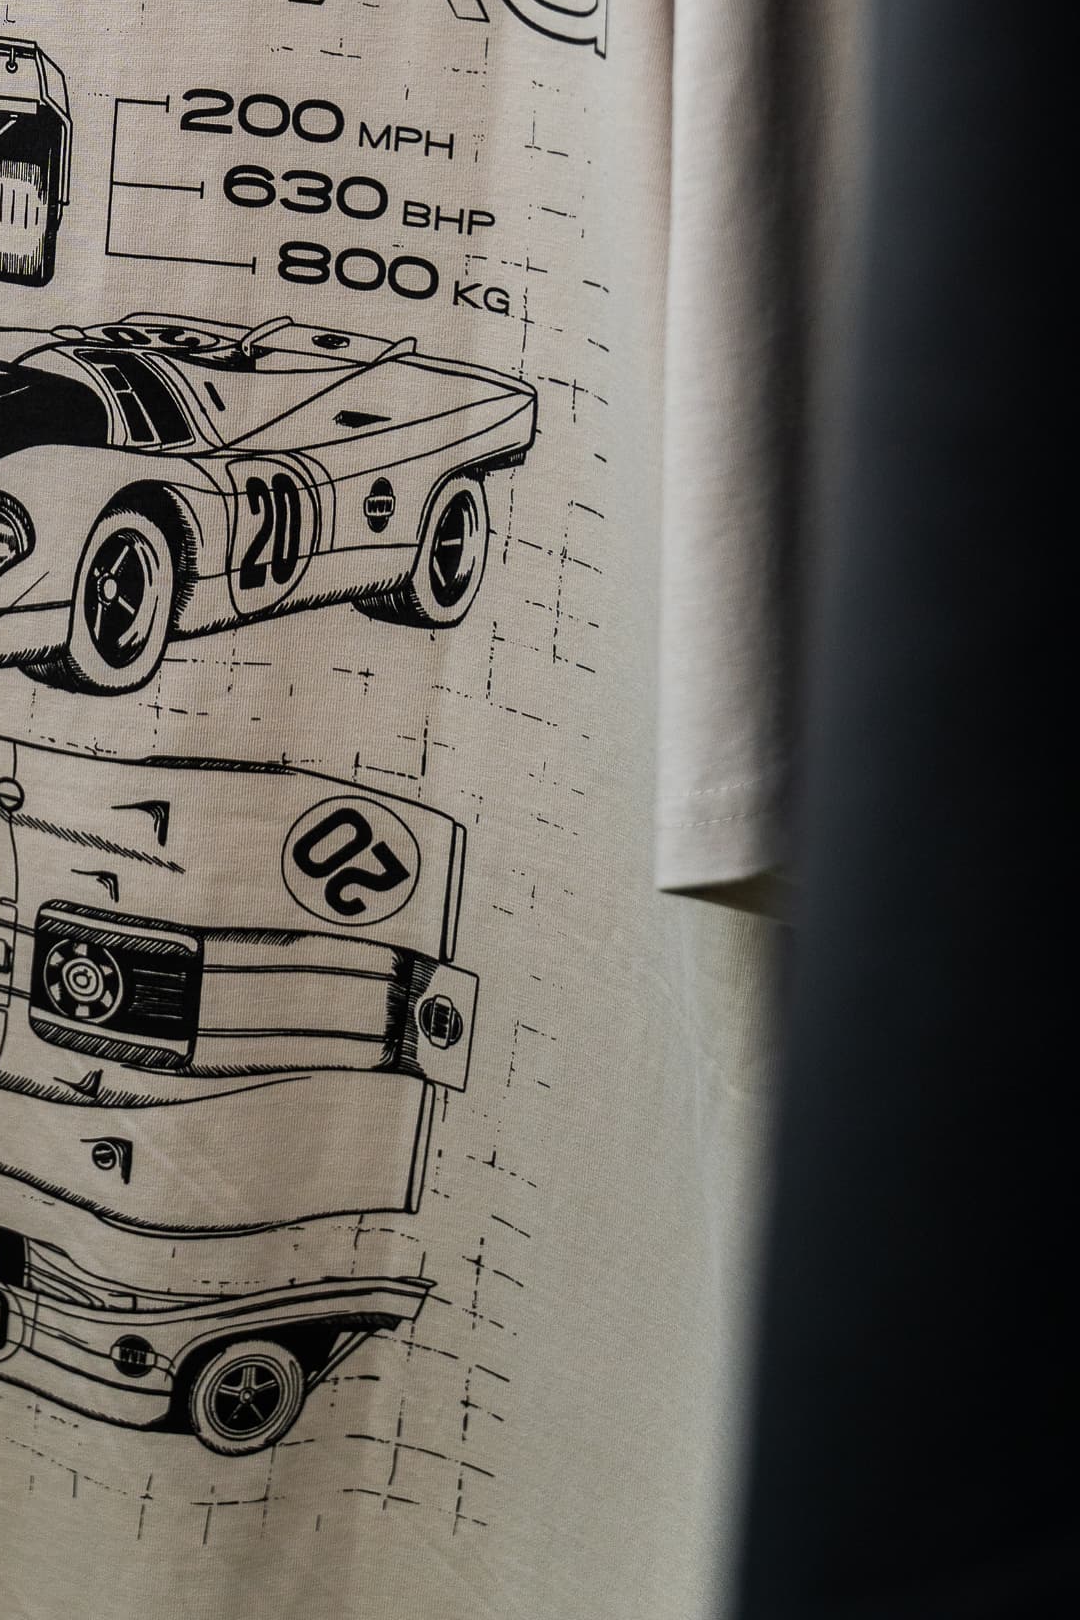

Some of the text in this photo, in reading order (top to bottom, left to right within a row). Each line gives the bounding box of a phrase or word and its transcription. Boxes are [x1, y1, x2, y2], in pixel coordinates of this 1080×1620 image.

[180, 88, 455, 159] 200 MPH
[222, 164, 496, 236] 630 BHP
[277, 241, 512, 316] 800 KG
[239, 472, 302, 590] 20
[292, 807, 411, 917] 20
